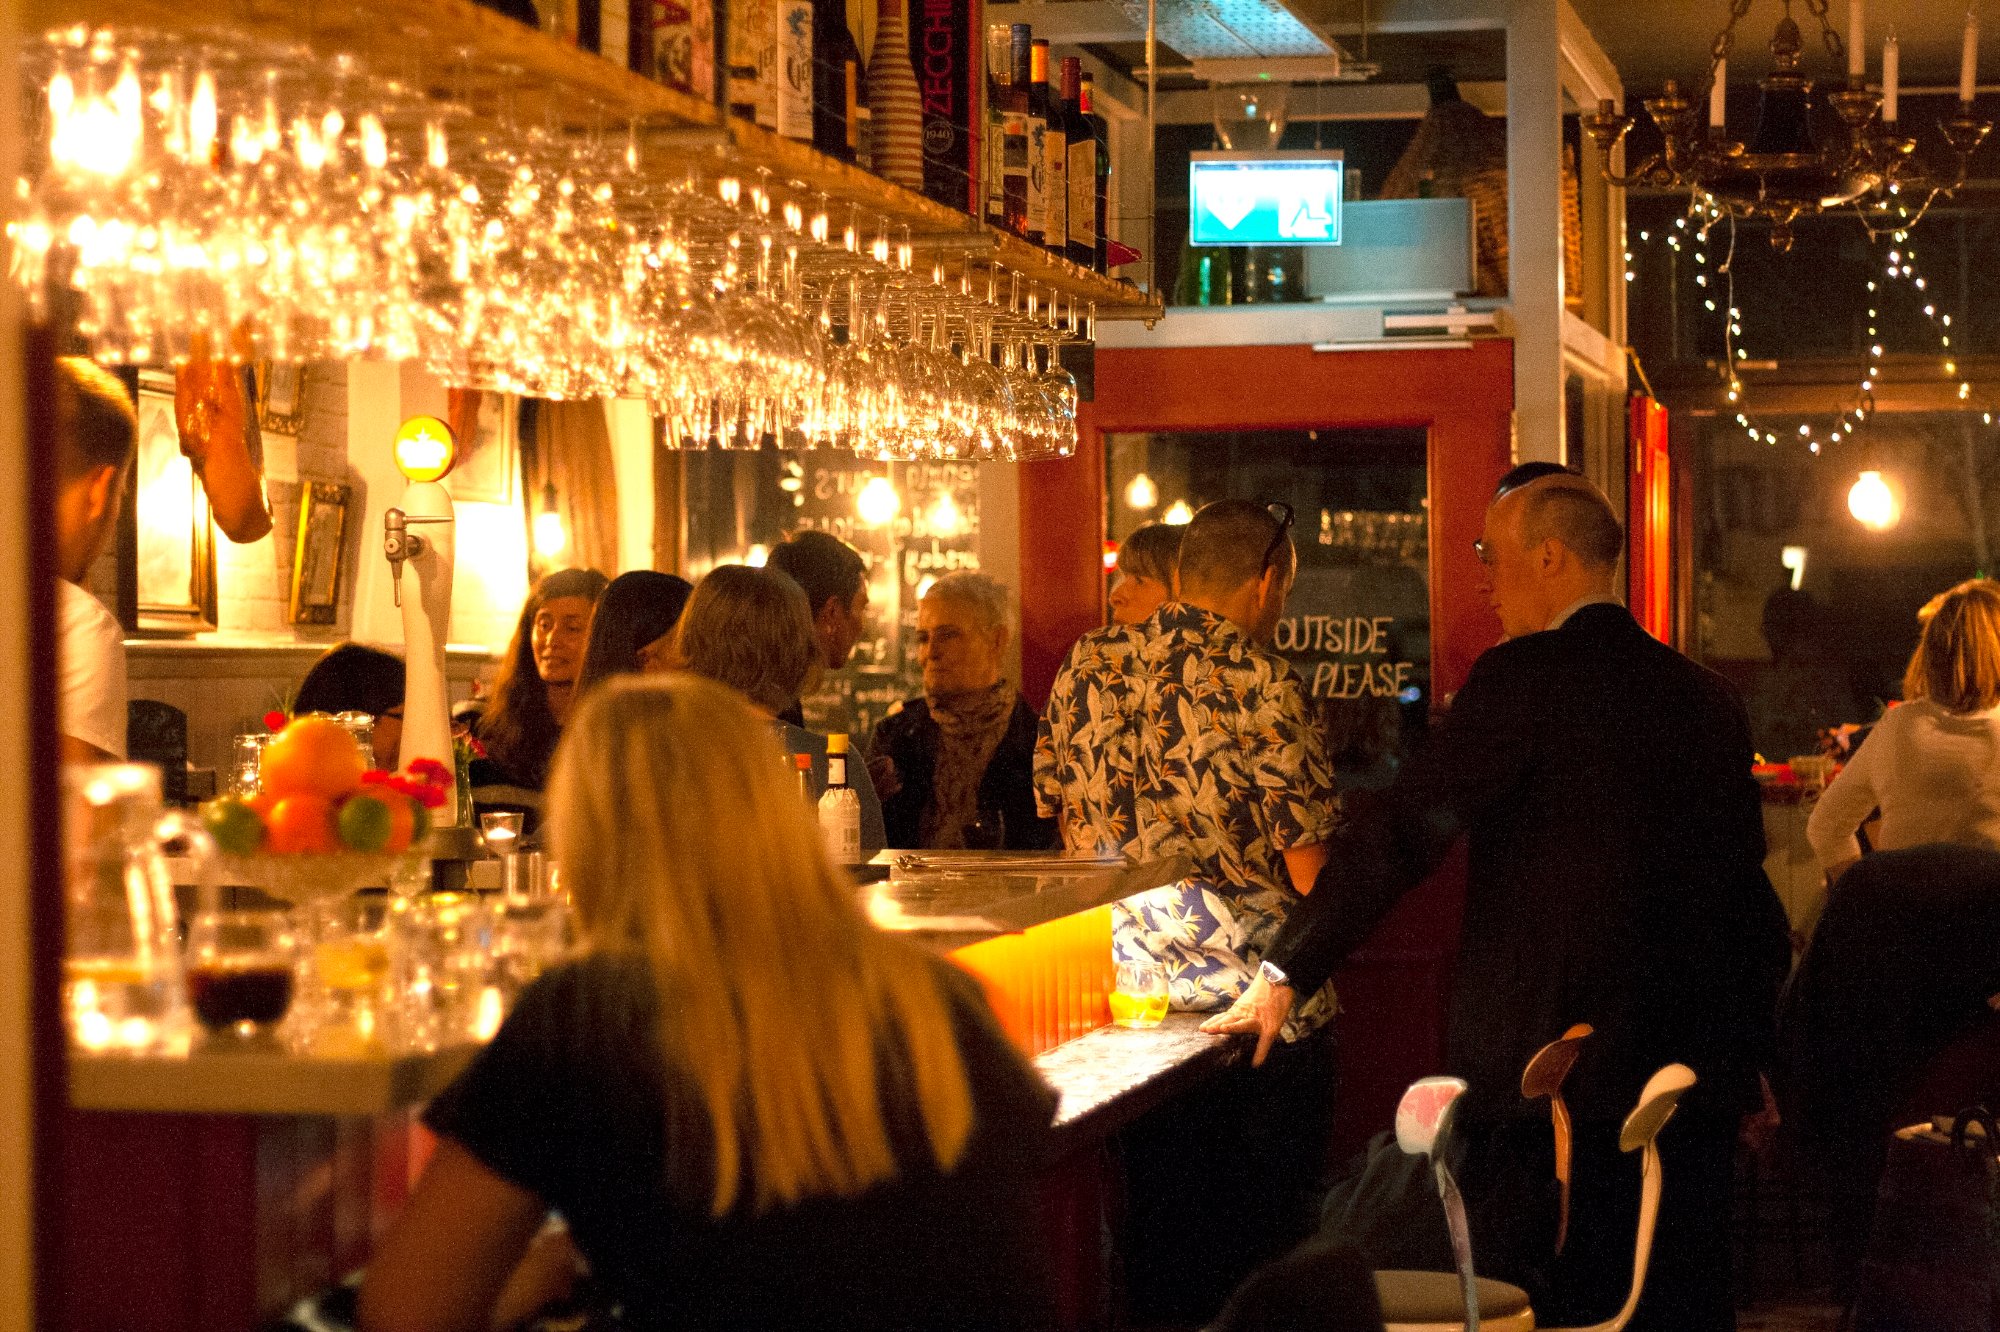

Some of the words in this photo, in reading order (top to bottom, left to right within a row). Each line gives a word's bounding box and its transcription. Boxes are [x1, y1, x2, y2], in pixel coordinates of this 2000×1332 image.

[926, 130, 950, 139] 1940
[1274, 614, 1394, 654] OUTSIDE
[1311, 661, 1413, 698] PLEASE
